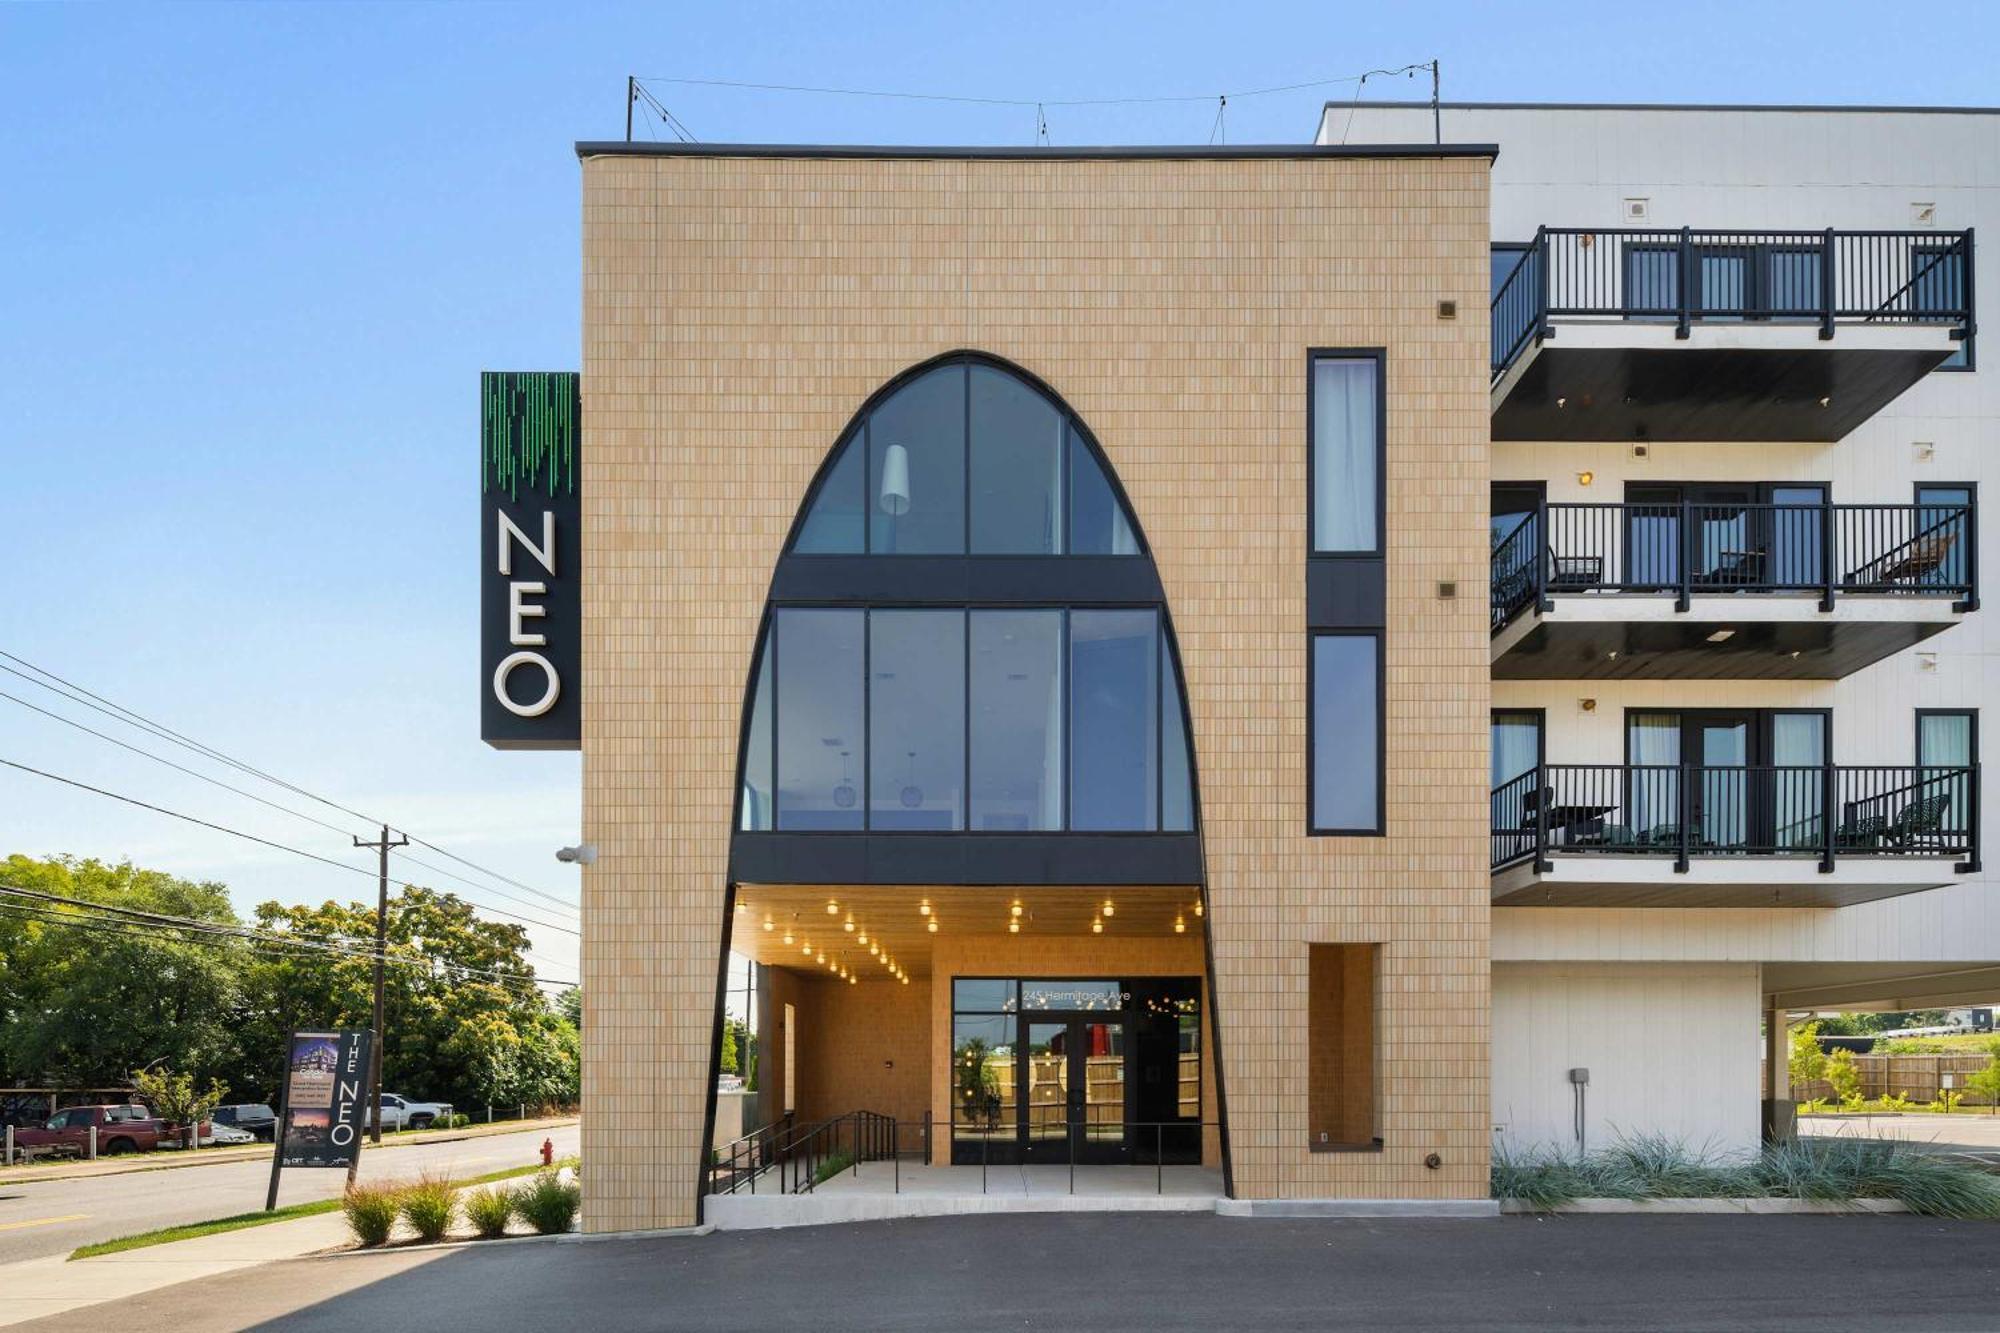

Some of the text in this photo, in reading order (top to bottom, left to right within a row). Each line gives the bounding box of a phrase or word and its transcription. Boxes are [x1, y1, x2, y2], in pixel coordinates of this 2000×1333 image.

[493, 508, 561, 717] NEO
[1023, 991, 1131, 1002] 245 Hermitage Ave
[347, 1033, 360, 1073] THE
[331, 1080, 359, 1146] NEO
